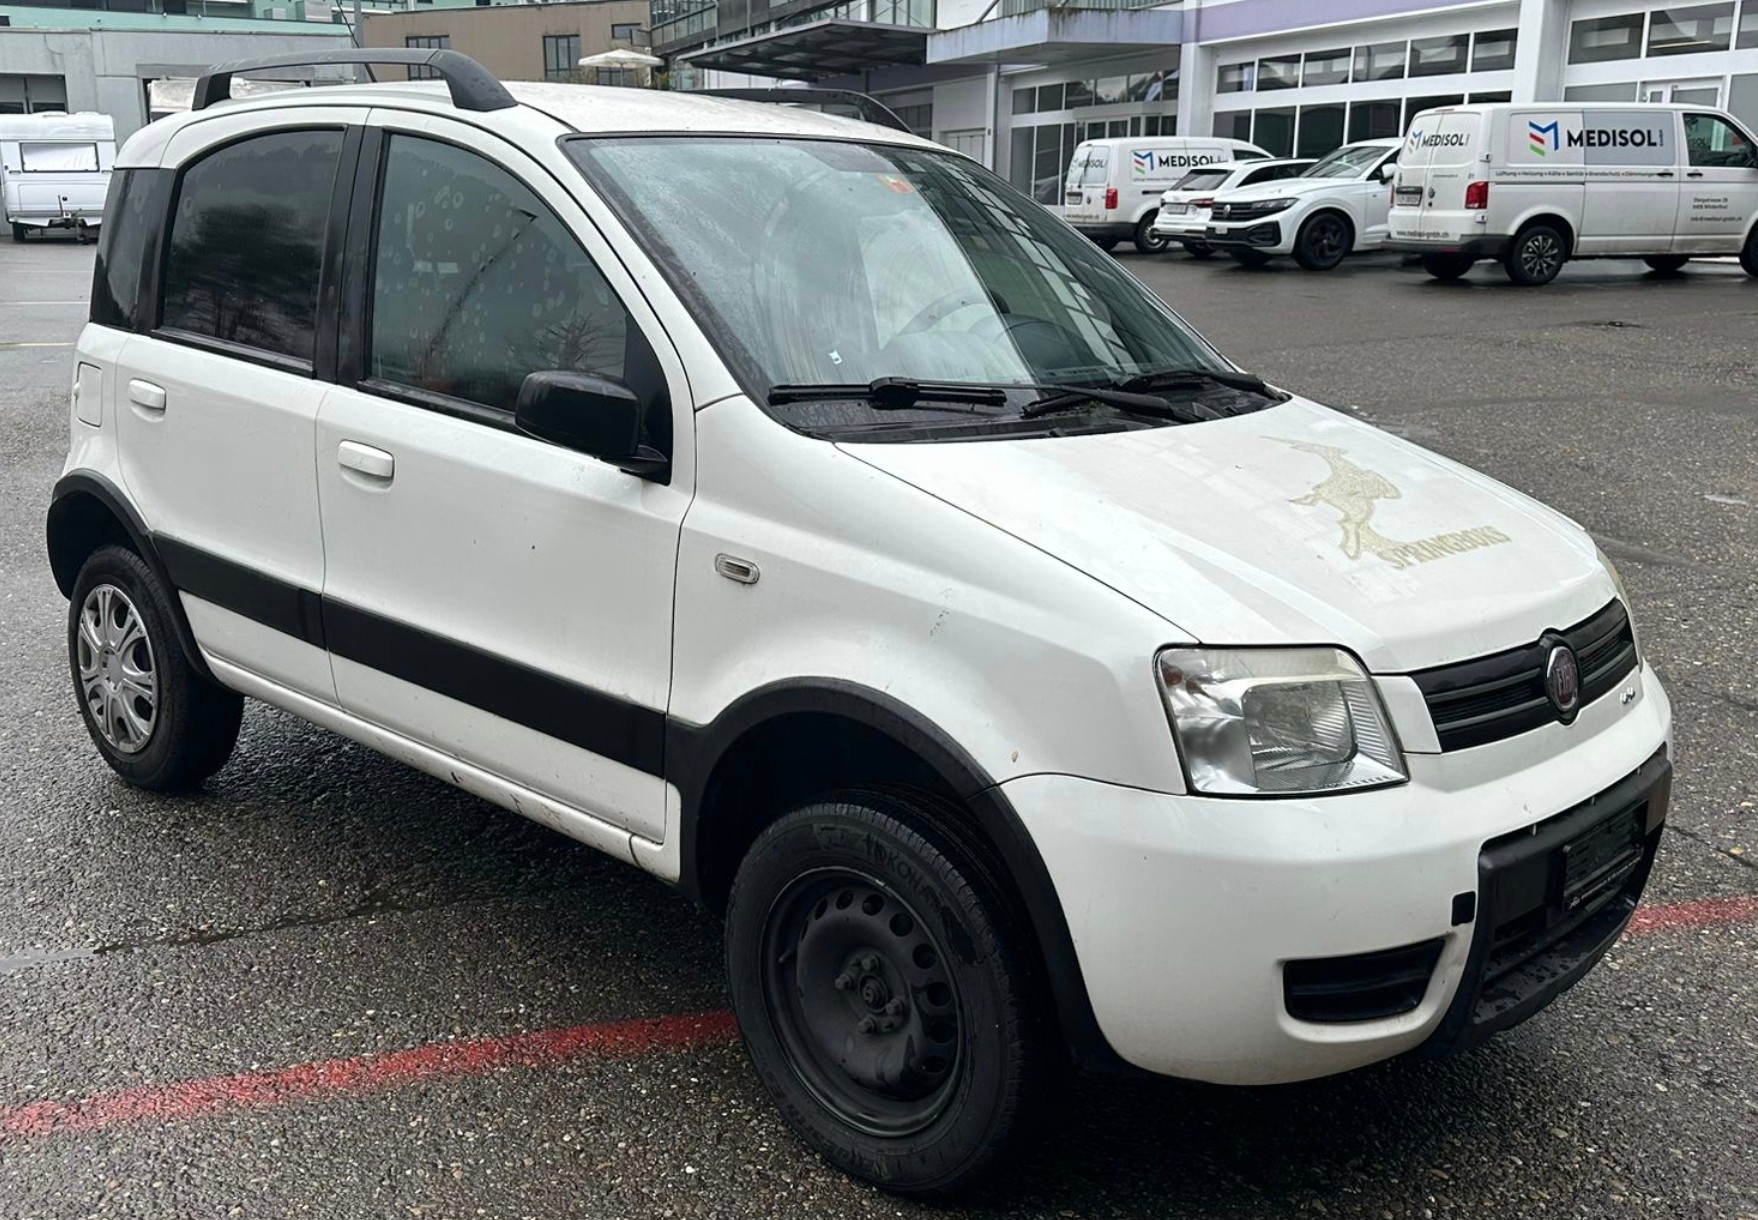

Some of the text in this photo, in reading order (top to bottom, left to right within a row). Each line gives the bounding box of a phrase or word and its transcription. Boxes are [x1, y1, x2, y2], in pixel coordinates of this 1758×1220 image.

[1421, 133, 1465, 147] MEDISOL
[1566, 129, 1657, 147] MEDISOL
[1376, 525, 1512, 570] SPRINGBOKS
